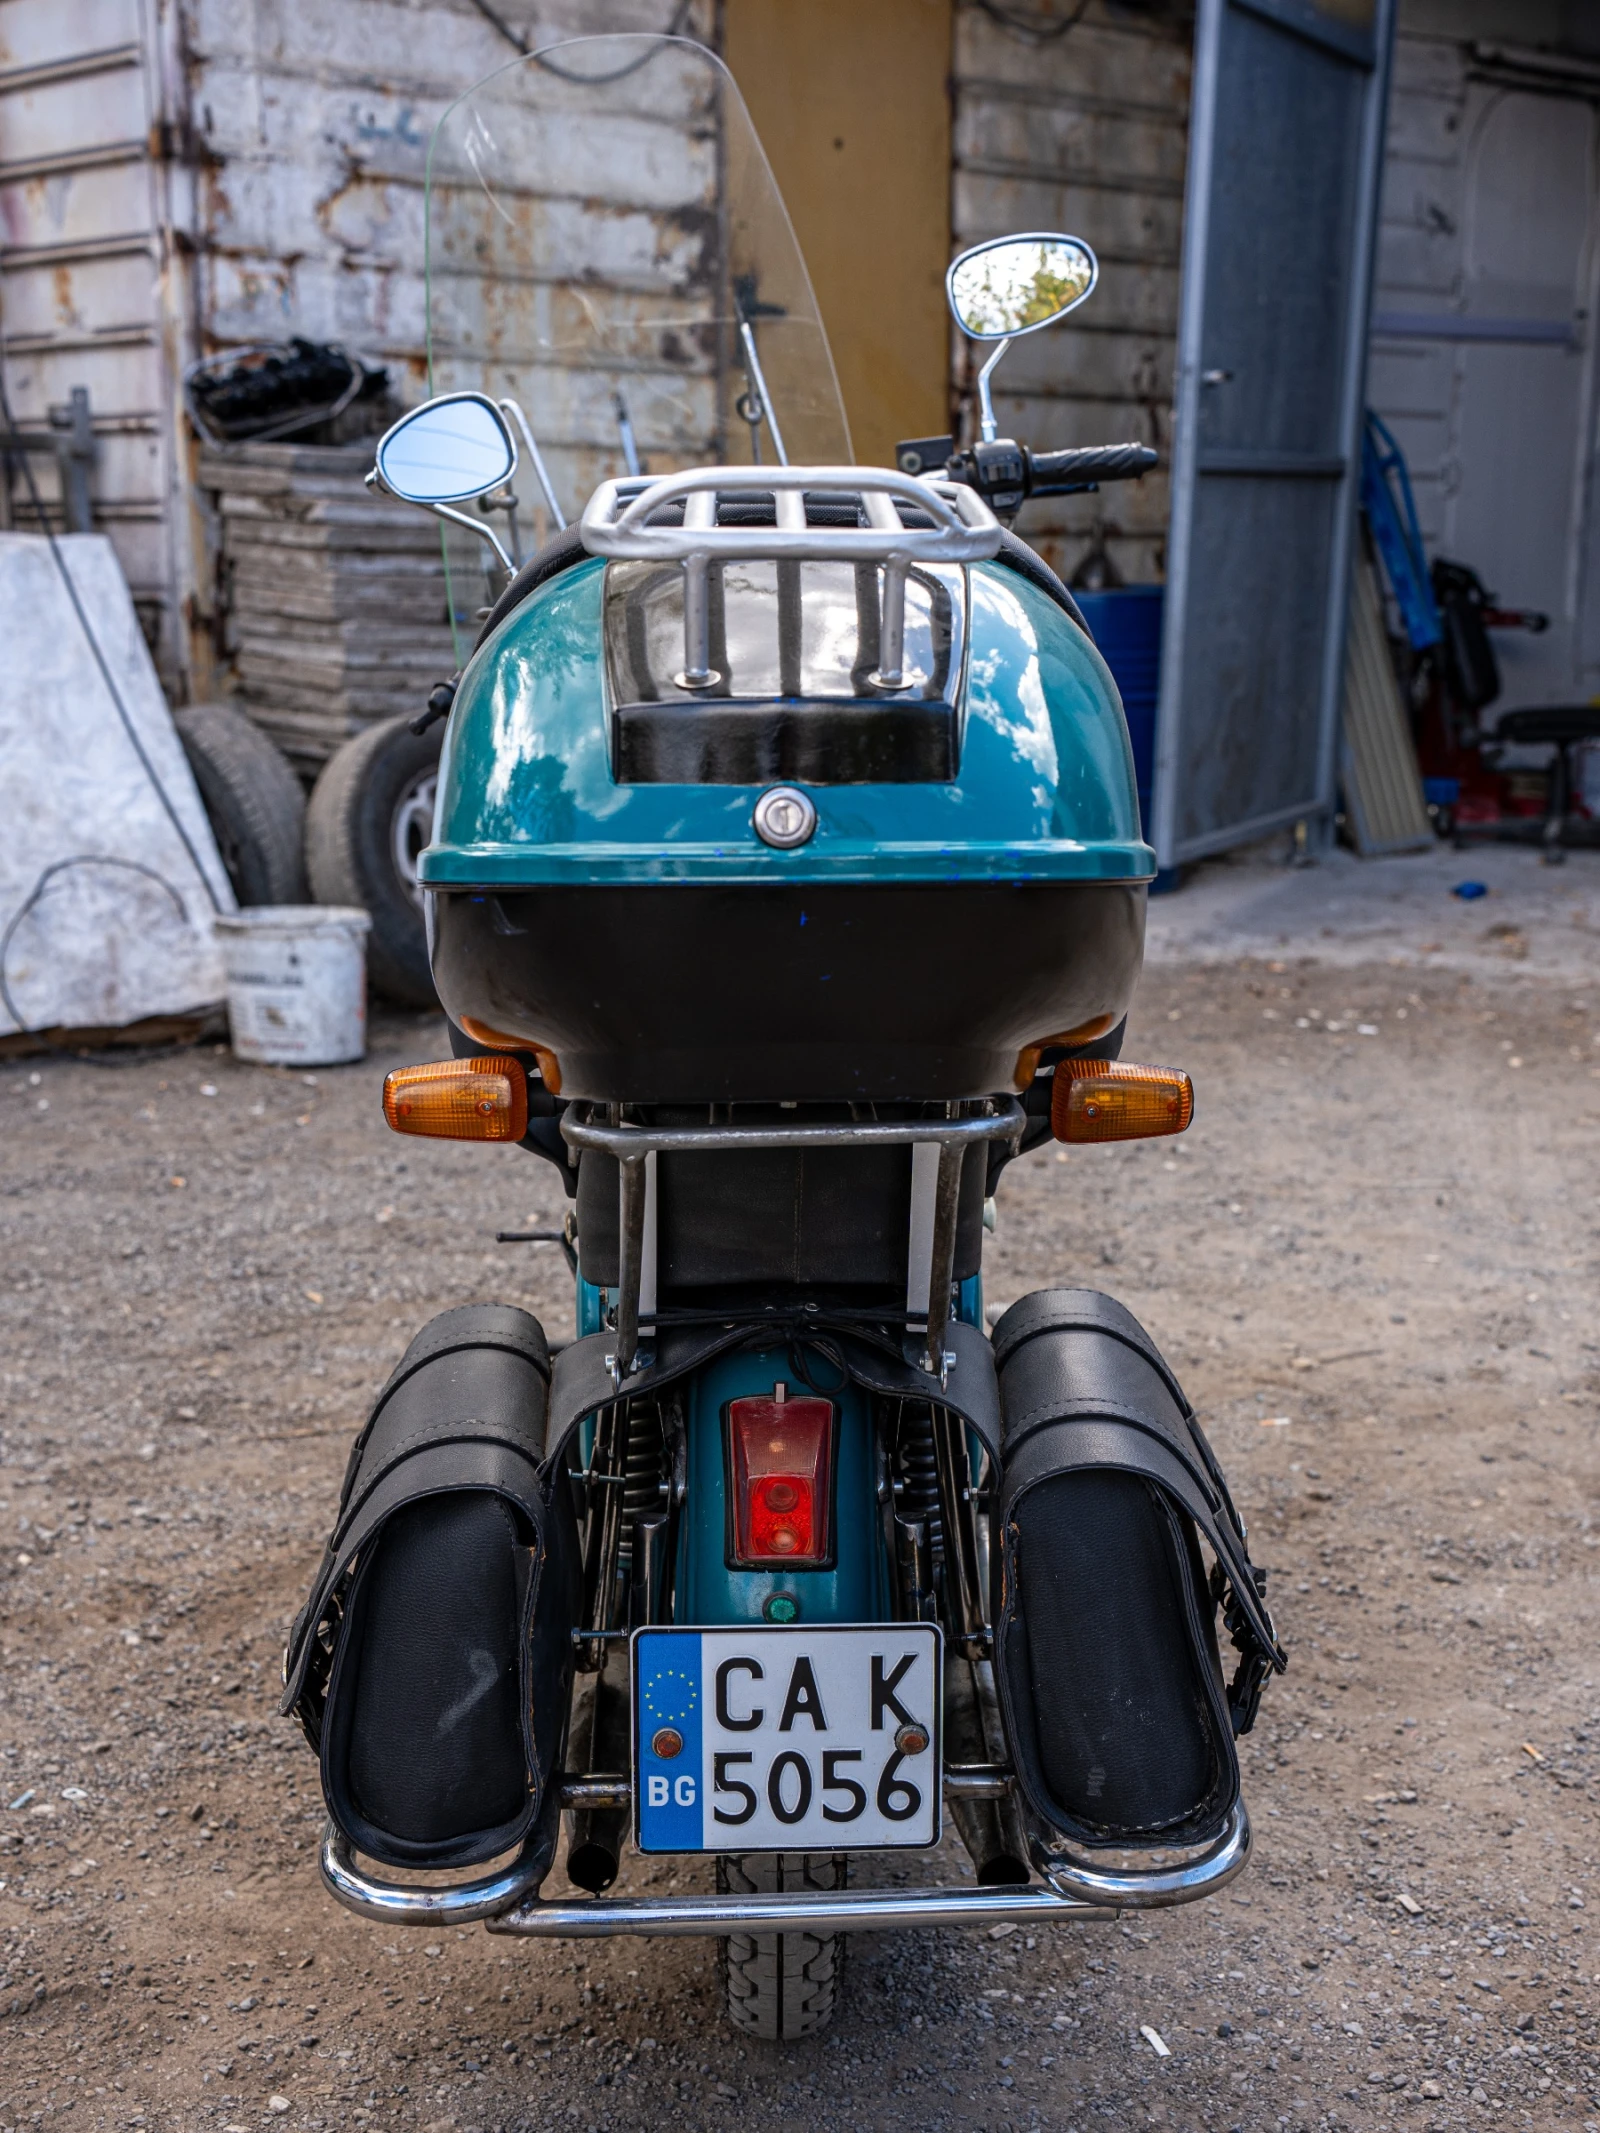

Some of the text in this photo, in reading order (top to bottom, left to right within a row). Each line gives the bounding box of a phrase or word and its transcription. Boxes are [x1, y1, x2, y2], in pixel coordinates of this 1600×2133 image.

[715, 1653, 919, 1732] CA K
[647, 1776, 696, 1807] BG
[713, 1750, 922, 1826] 5056
